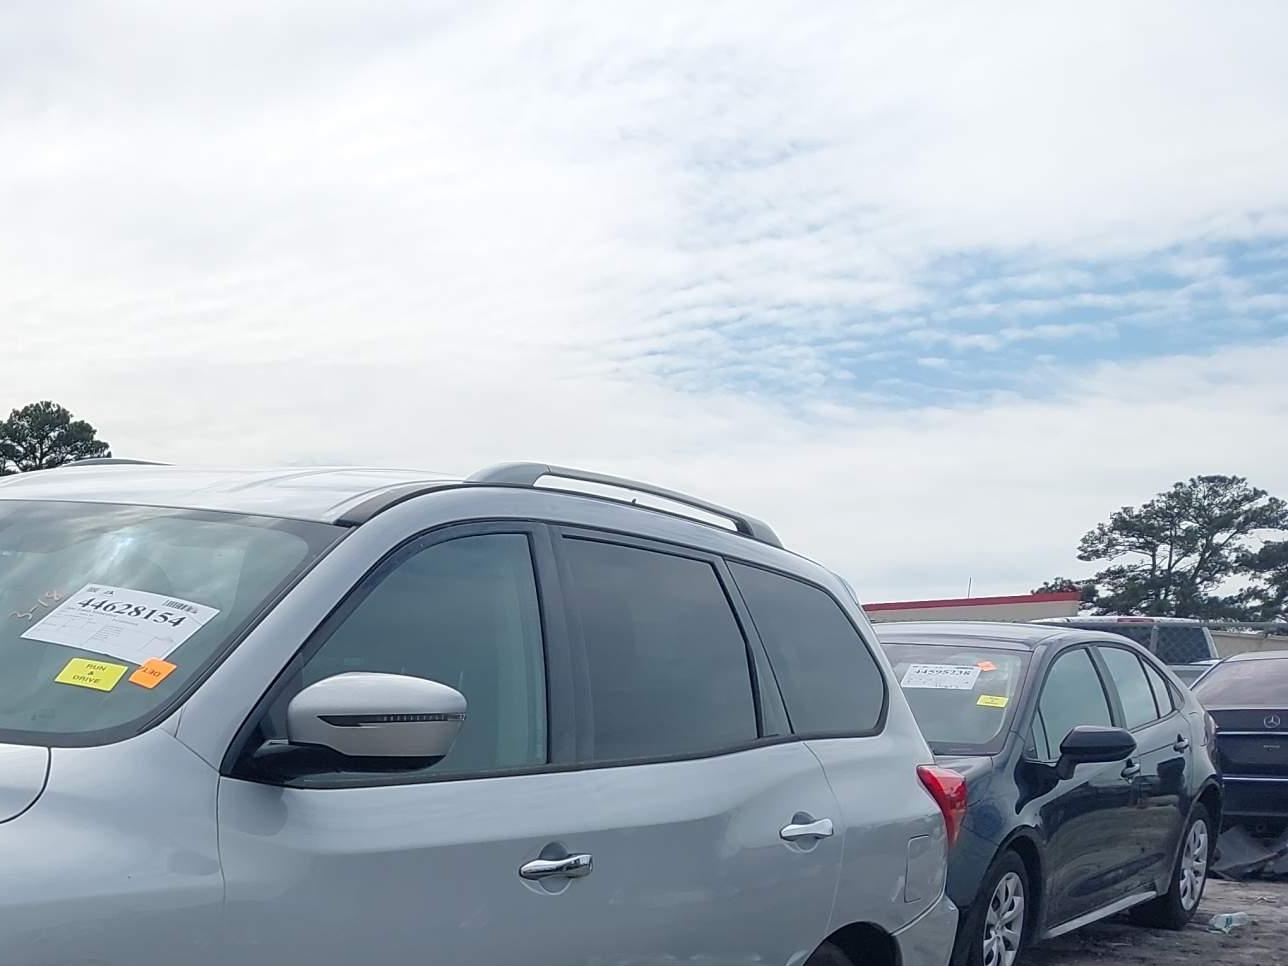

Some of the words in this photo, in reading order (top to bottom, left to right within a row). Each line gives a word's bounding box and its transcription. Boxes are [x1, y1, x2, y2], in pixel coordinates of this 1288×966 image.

[78, 597, 186, 628] 44628154
[86, 663, 108, 672] RUN
[72, 675, 101, 684] DRIVE
